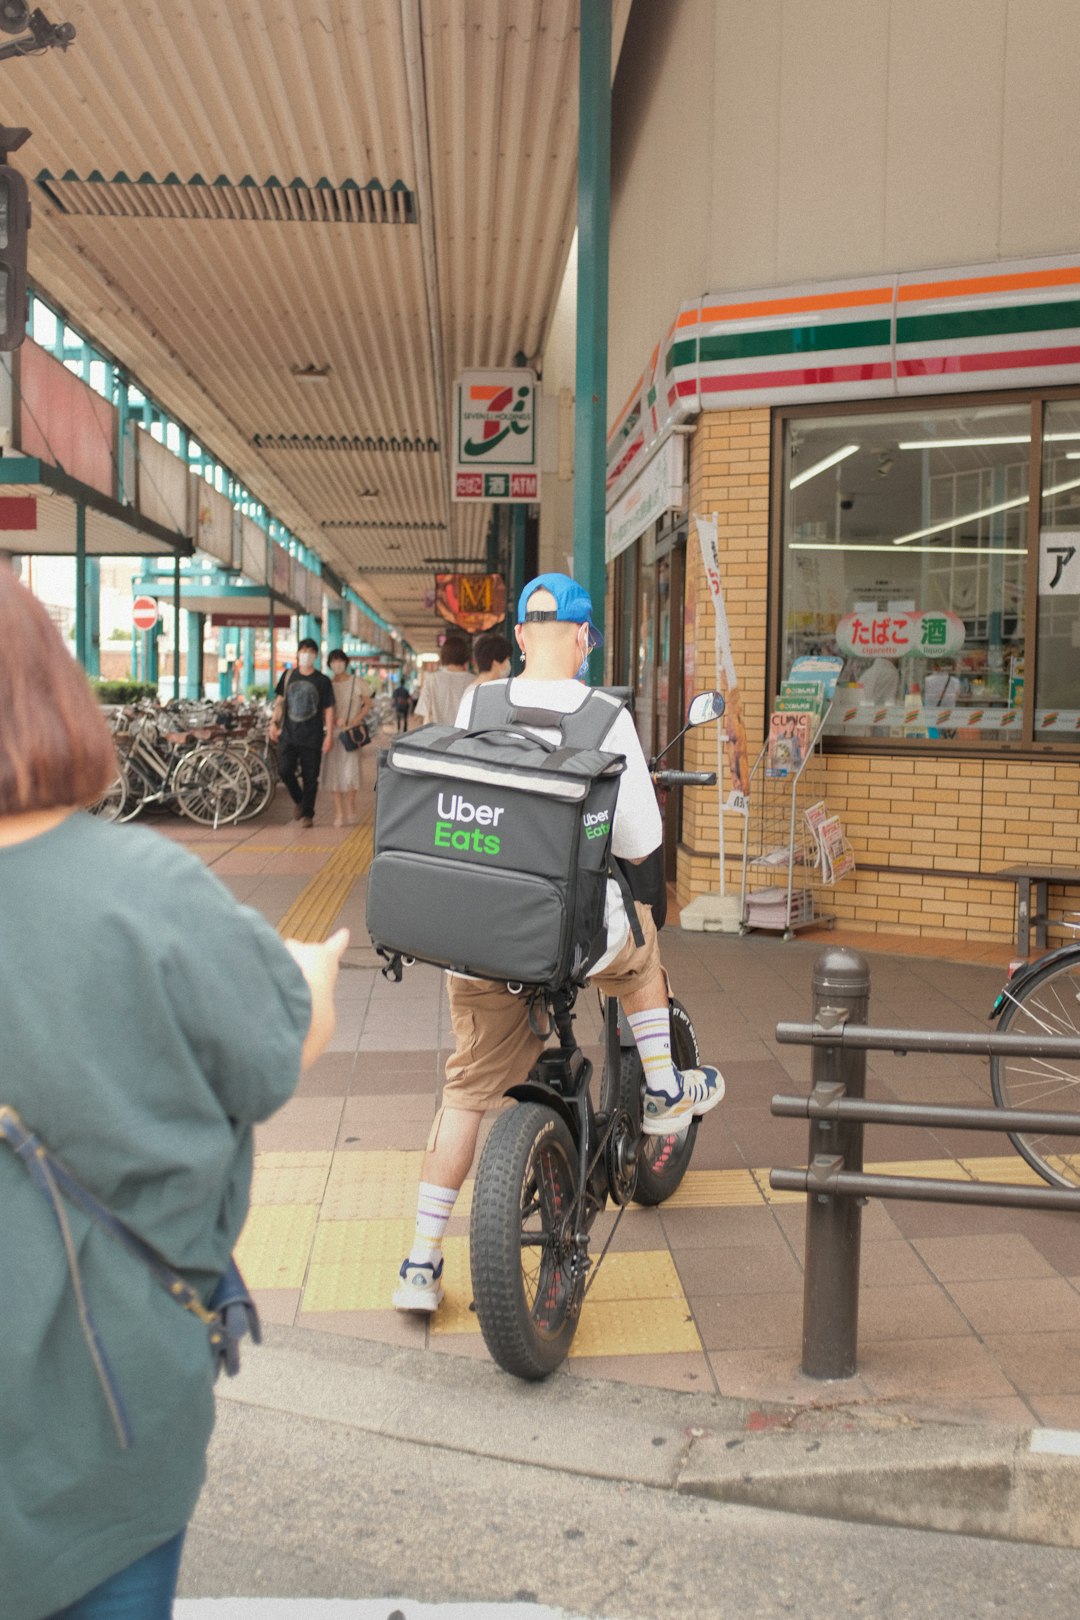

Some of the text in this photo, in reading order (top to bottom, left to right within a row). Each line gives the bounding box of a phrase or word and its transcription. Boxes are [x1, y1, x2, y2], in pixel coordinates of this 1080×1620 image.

[512, 477, 536, 495] ATM
[1047, 546, 1076, 588] ア
[852, 618, 947, 645] たばこ 酒
[923, 647, 945, 655] liquor
[438, 793, 504, 826] Uber
[583, 810, 608, 827] Uber
[434, 821, 501, 855] Eats
